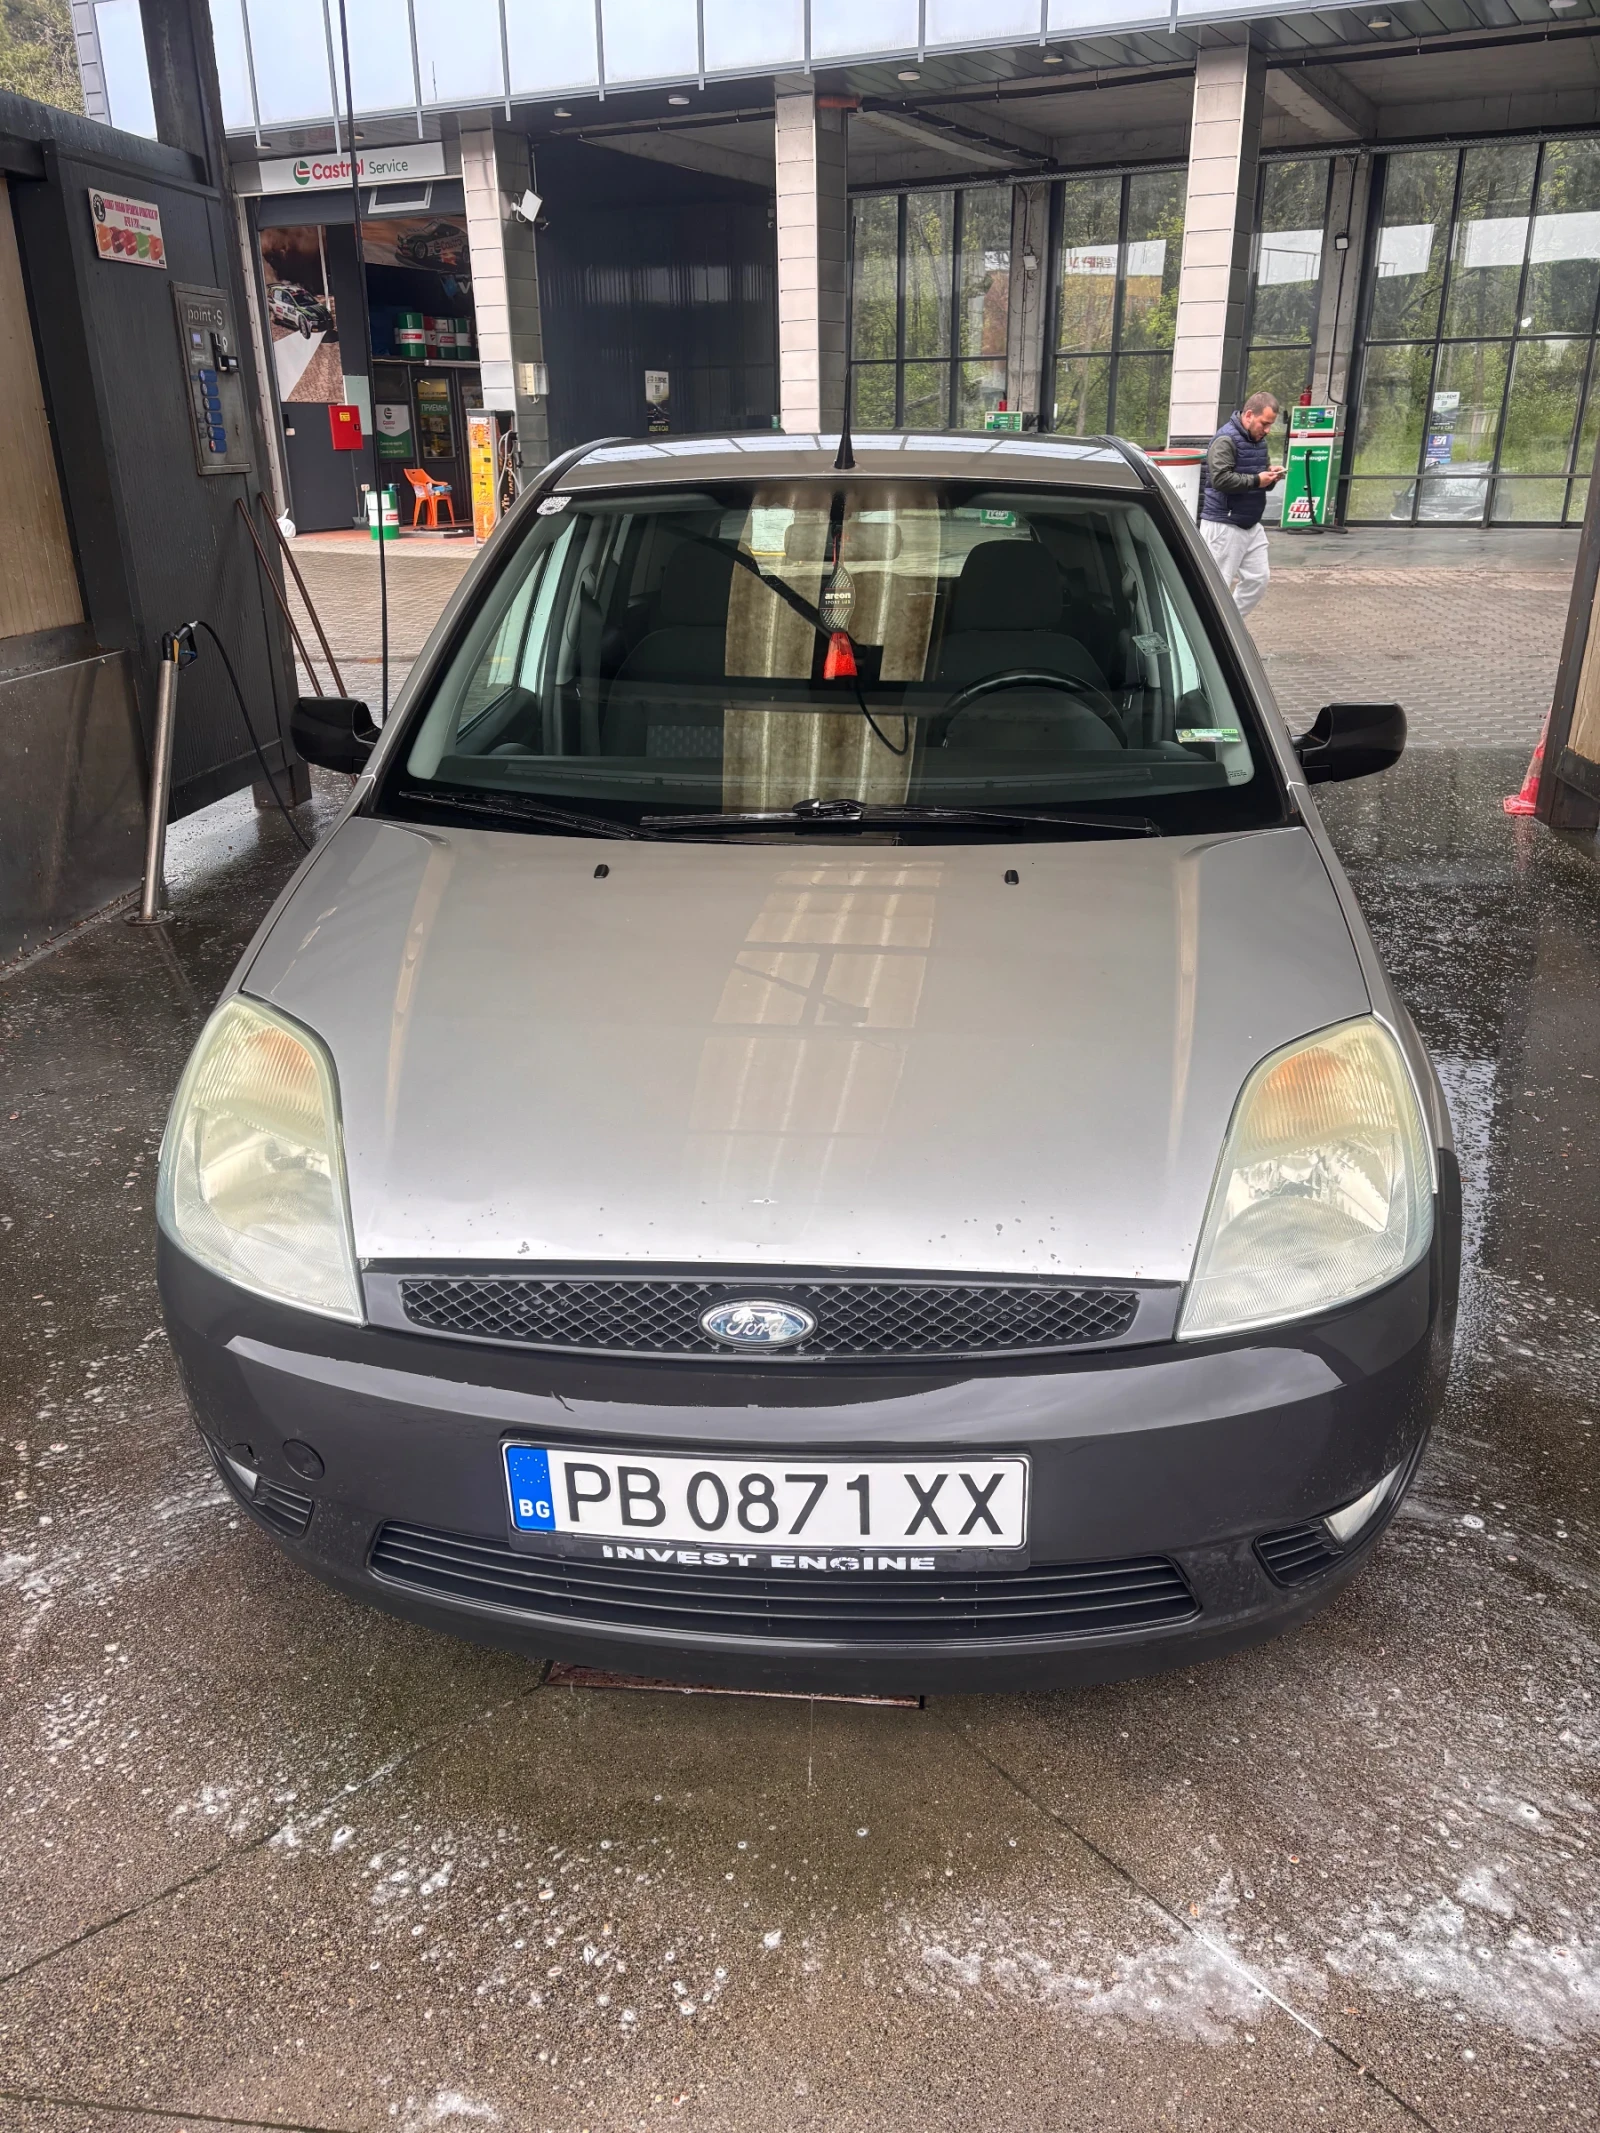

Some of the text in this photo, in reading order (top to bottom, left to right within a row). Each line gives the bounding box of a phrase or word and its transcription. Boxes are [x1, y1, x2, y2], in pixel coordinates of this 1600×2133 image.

[369, 159, 409, 175] Service
[188, 307, 212, 323] point
[824, 592, 852, 600] areon
[725, 1307, 786, 1336] Ford
[518, 1498, 550, 1519] BG
[564, 1462, 1005, 1536] PB 0871 XX
[602, 1545, 935, 1571] INVEST ENGINE
